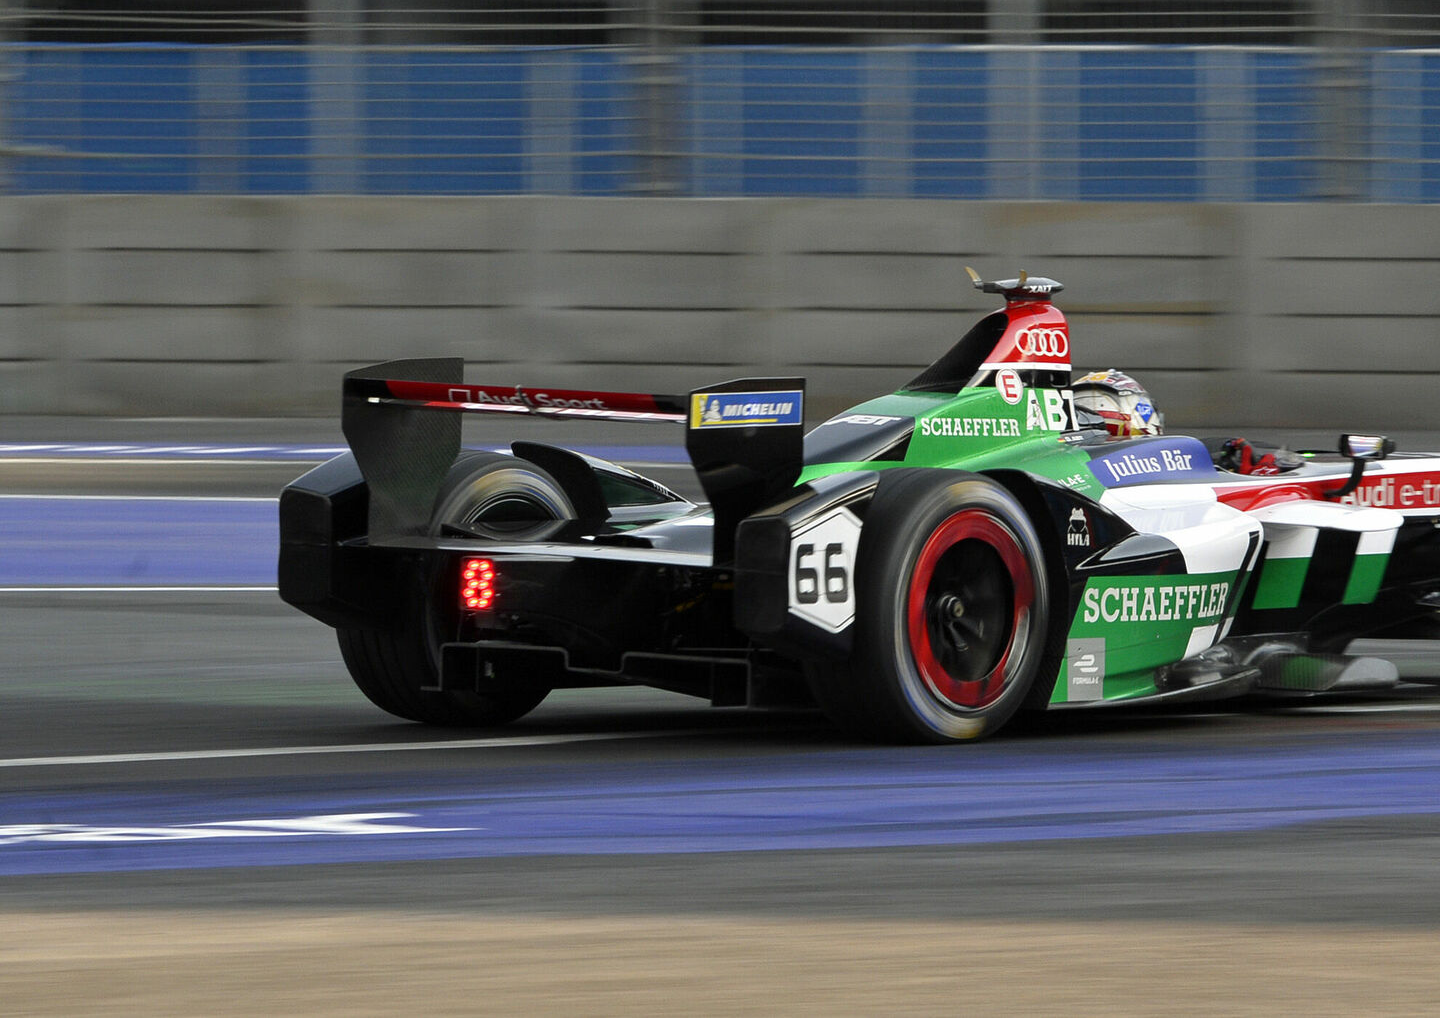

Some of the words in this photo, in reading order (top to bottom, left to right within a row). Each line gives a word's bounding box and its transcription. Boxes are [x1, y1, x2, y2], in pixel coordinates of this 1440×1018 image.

[1001, 375, 1018, 398] E
[534, 393, 608, 410] Sport
[723, 402, 793, 417] MICHELIN
[1026, 389, 1080, 431] ABT
[920, 417, 1021, 437] SCHAEFFLER
[1103, 454, 1161, 482] Julius
[1160, 449, 1193, 471] Bär
[1067, 533, 1090, 546] HYLA
[795, 542, 848, 604] 66
[1084, 582, 1229, 623] SCHAEFFLER
